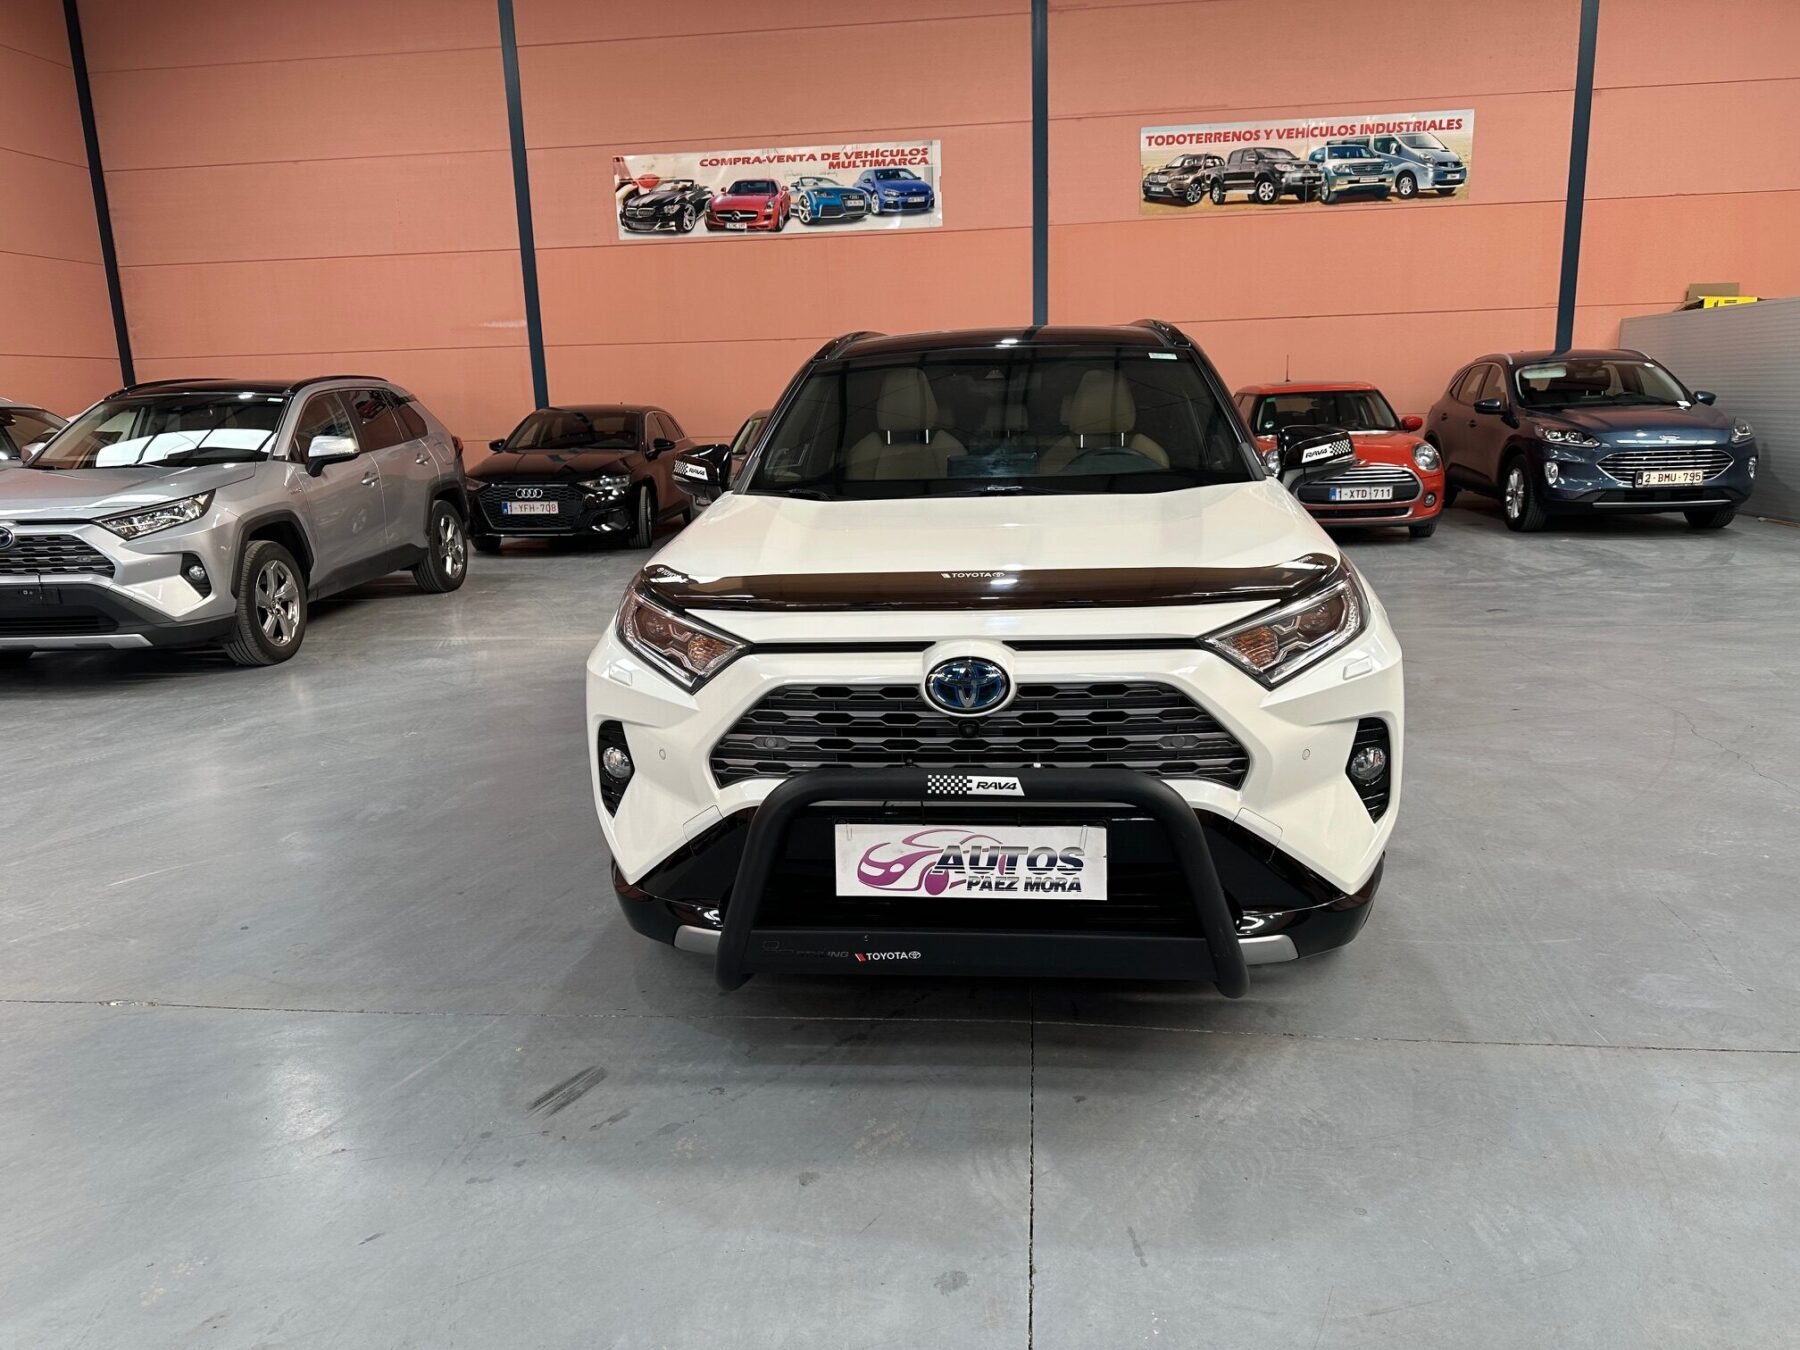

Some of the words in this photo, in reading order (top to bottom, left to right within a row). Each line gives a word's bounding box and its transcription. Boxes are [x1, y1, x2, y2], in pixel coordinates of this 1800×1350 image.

[1146, 129, 1261, 147] TODOTERRENOS
[1264, 128, 1274, 141] Y
[1276, 121, 1356, 141] VEHÍCULOS
[1360, 117, 1463, 136] INDUSTRIALES
[699, 153, 817, 168] COMPRA-VENTA
[820, 152, 840, 161] DE
[843, 147, 929, 161] VEHÍCULOS
[828, 157, 929, 170] MULTIMARCA
[1338, 489, 1392, 500] 1-XTD-711
[508, 503, 557, 514] 1-YFH-708
[976, 780, 1017, 791] RAV4
[931, 845, 1085, 876] AUTOS
[1023, 876, 1083, 892] MORA
[866, 951, 908, 960] TOYOTA
